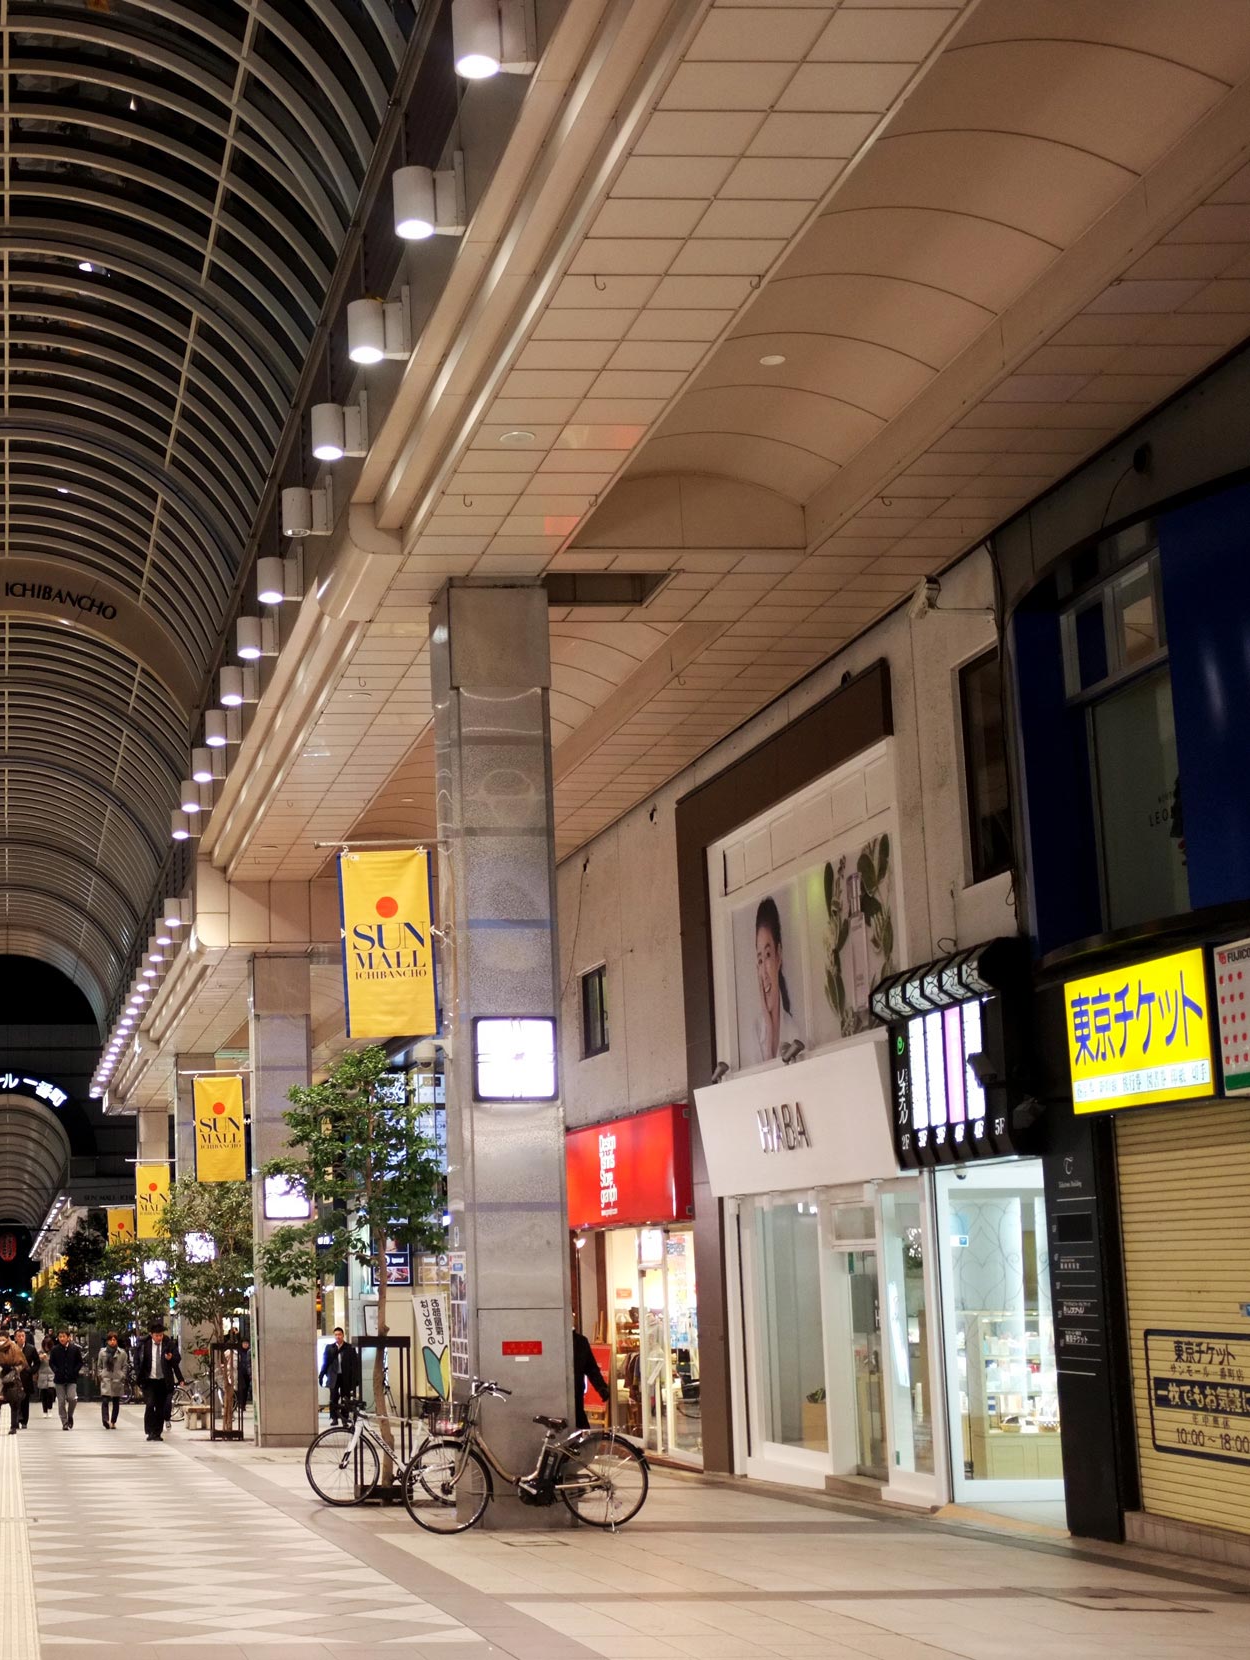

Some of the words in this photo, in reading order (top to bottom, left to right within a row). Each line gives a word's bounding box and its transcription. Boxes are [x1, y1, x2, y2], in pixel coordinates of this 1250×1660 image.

[5, 582, 117, 620] ICHIBANCHO
[352, 921, 426, 951] SUN
[354, 950, 426, 970] MALL
[355, 969, 427, 981] ICHIBANCHO
[1070, 969, 1203, 1066] 東京チケット
[23, 1078, 67, 1107] 一番町
[199, 1117, 241, 1133] SUN
[757, 1101, 810, 1152] HABA
[995, 1117, 1005, 1135] 5F
[200, 1132, 241, 1144] MALL
[139, 1193, 169, 1203] SUN
[1173, 1340, 1236, 1366] 東京チケット
